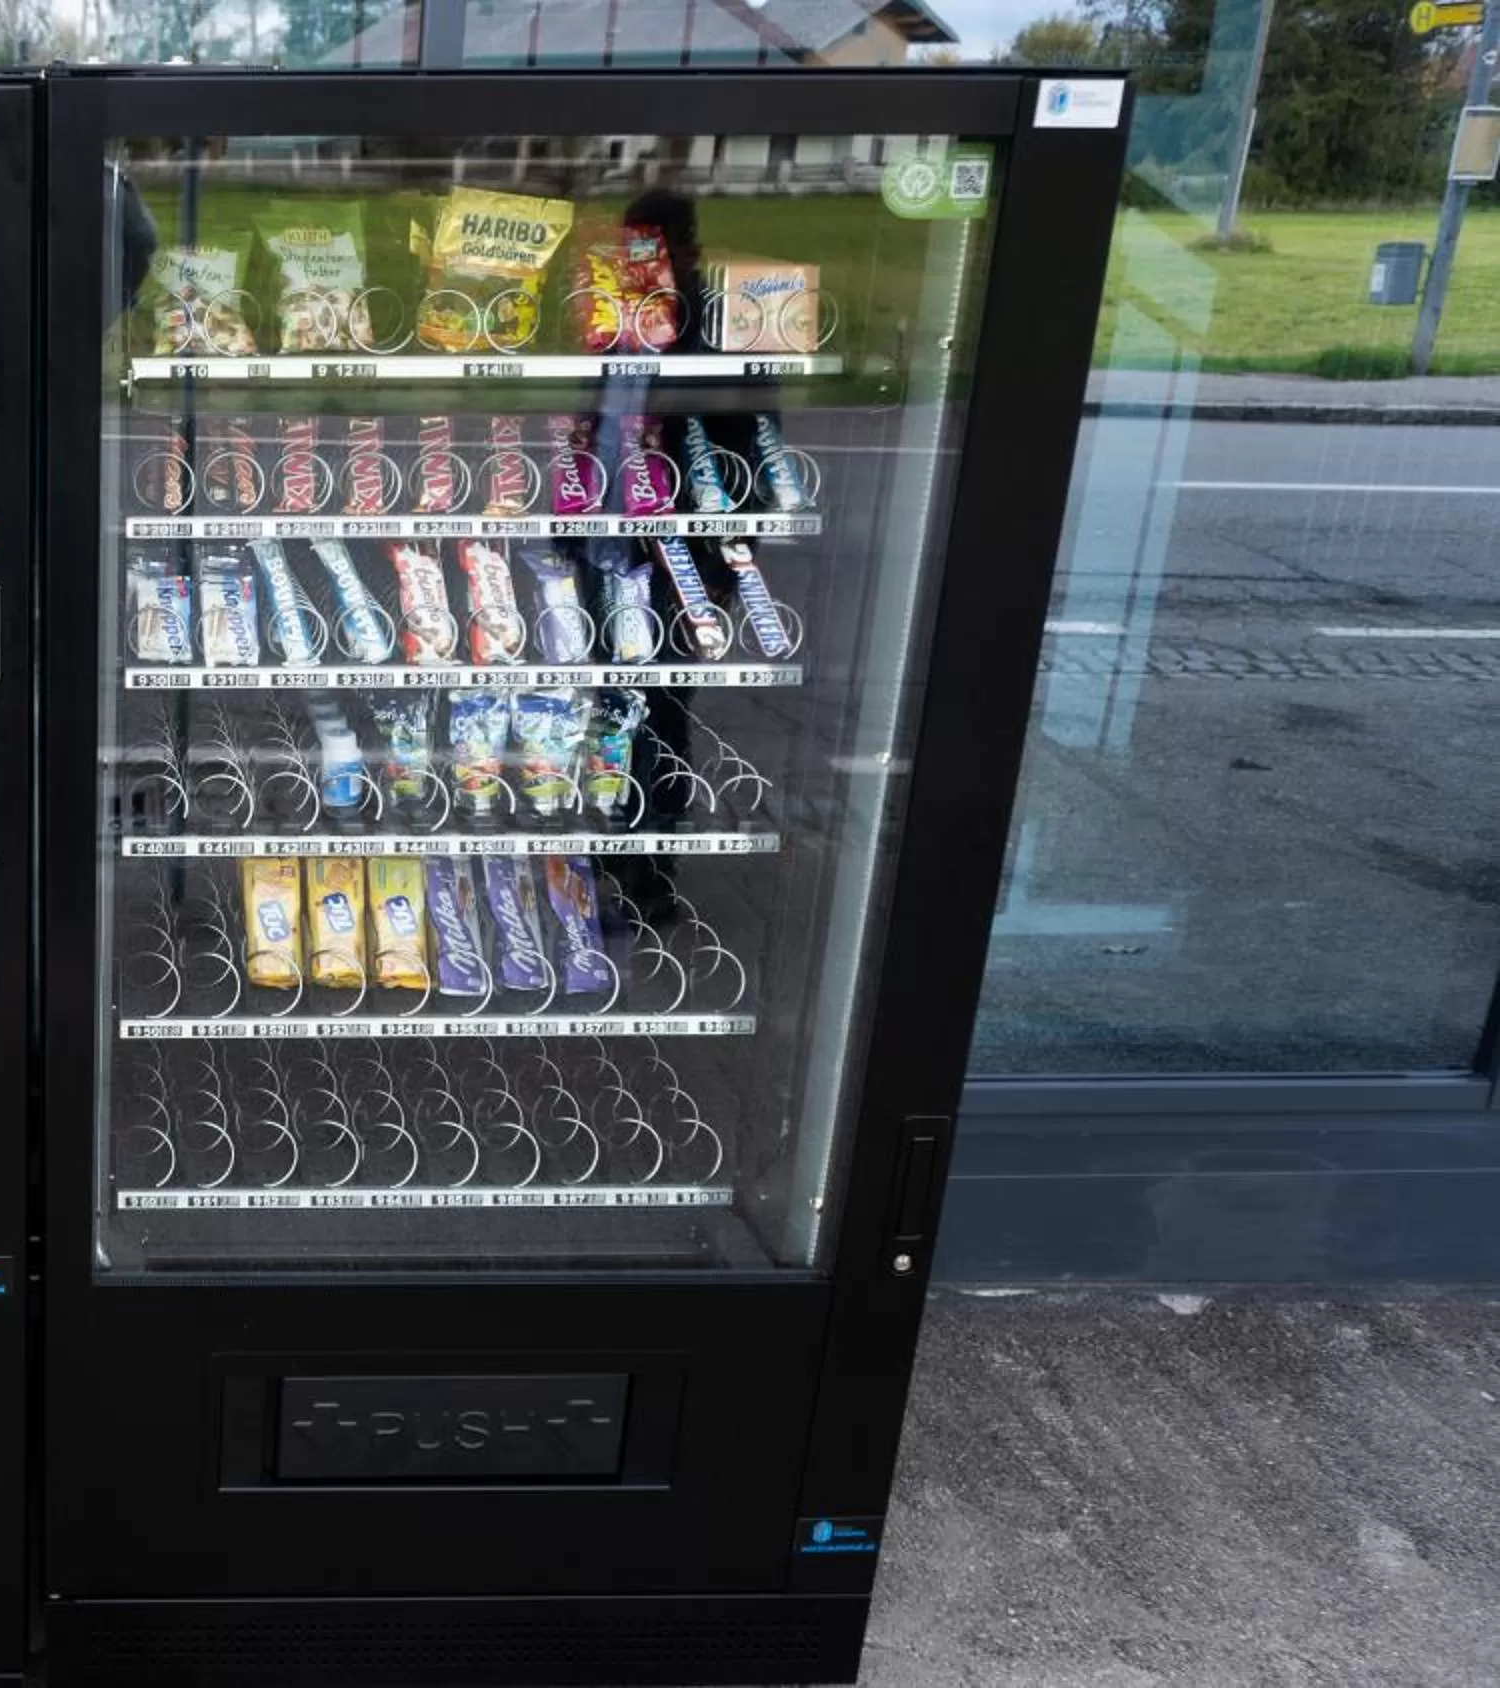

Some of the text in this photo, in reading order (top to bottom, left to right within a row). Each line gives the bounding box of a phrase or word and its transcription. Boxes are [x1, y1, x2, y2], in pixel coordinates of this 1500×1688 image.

[462, 212, 547, 246] HARIBO
[258, 901, 287, 941] TUC
[327, 895, 354, 932] TUC
[390, 896, 417, 934] TUC
[436, 891, 476, 974] Milka
[499, 890, 534, 973] Milka
[372, 1411, 536, 1449] PUSH
